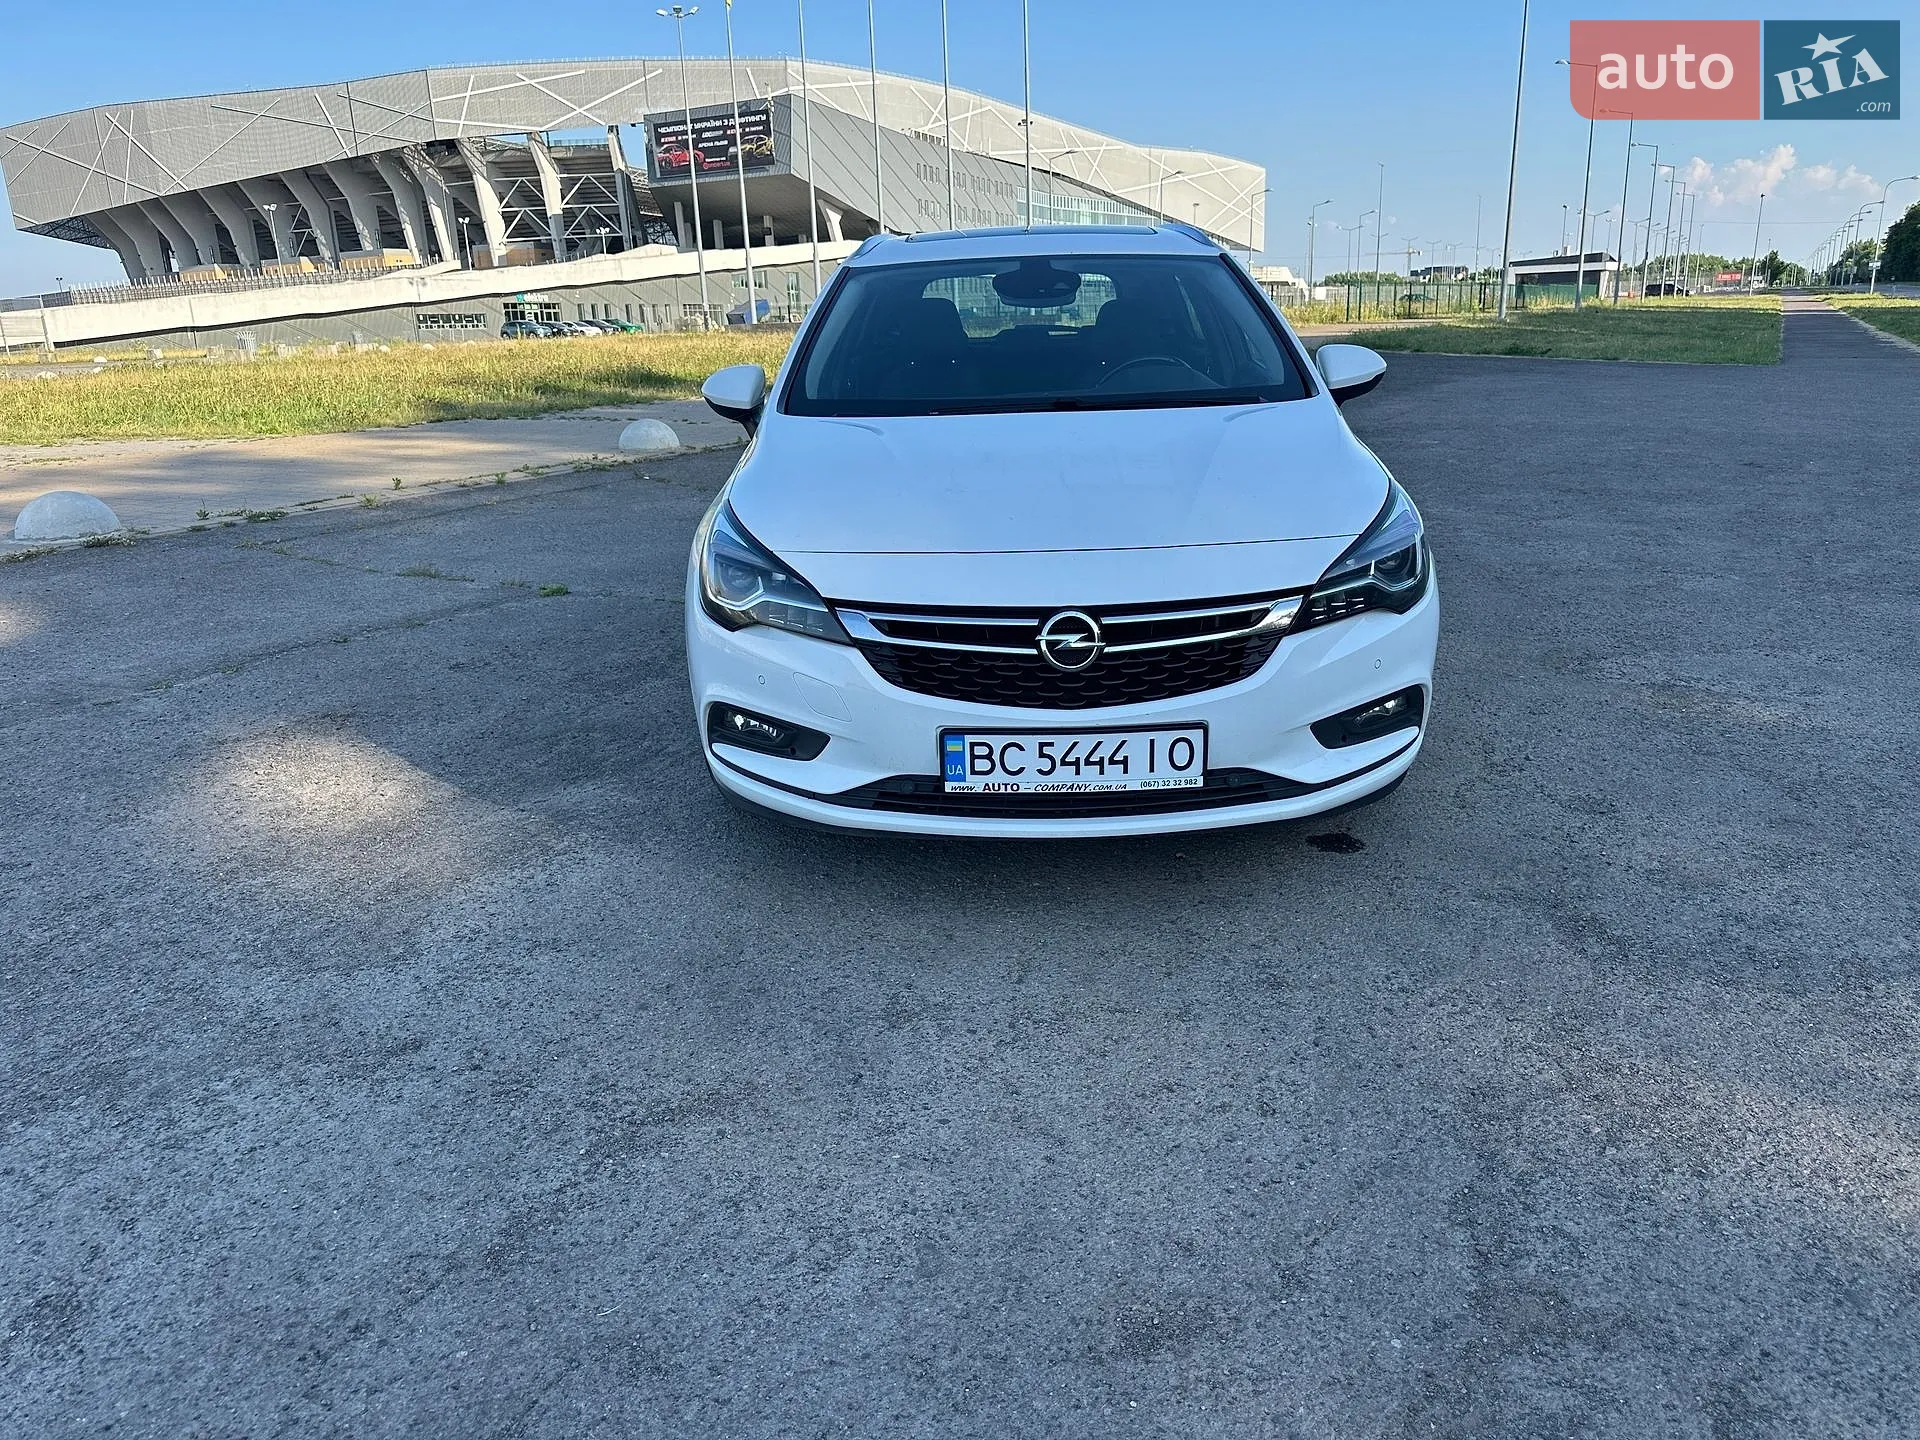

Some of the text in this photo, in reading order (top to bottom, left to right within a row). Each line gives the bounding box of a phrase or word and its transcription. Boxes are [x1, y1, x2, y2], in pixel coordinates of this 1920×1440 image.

[968, 741, 1027, 777] BC
[1035, 739, 1130, 777] 5444
[947, 766, 964, 776] UA
[982, 782, 1021, 792] AUTO
[1139, 777, 1199, 789] (067) 32 32 982
